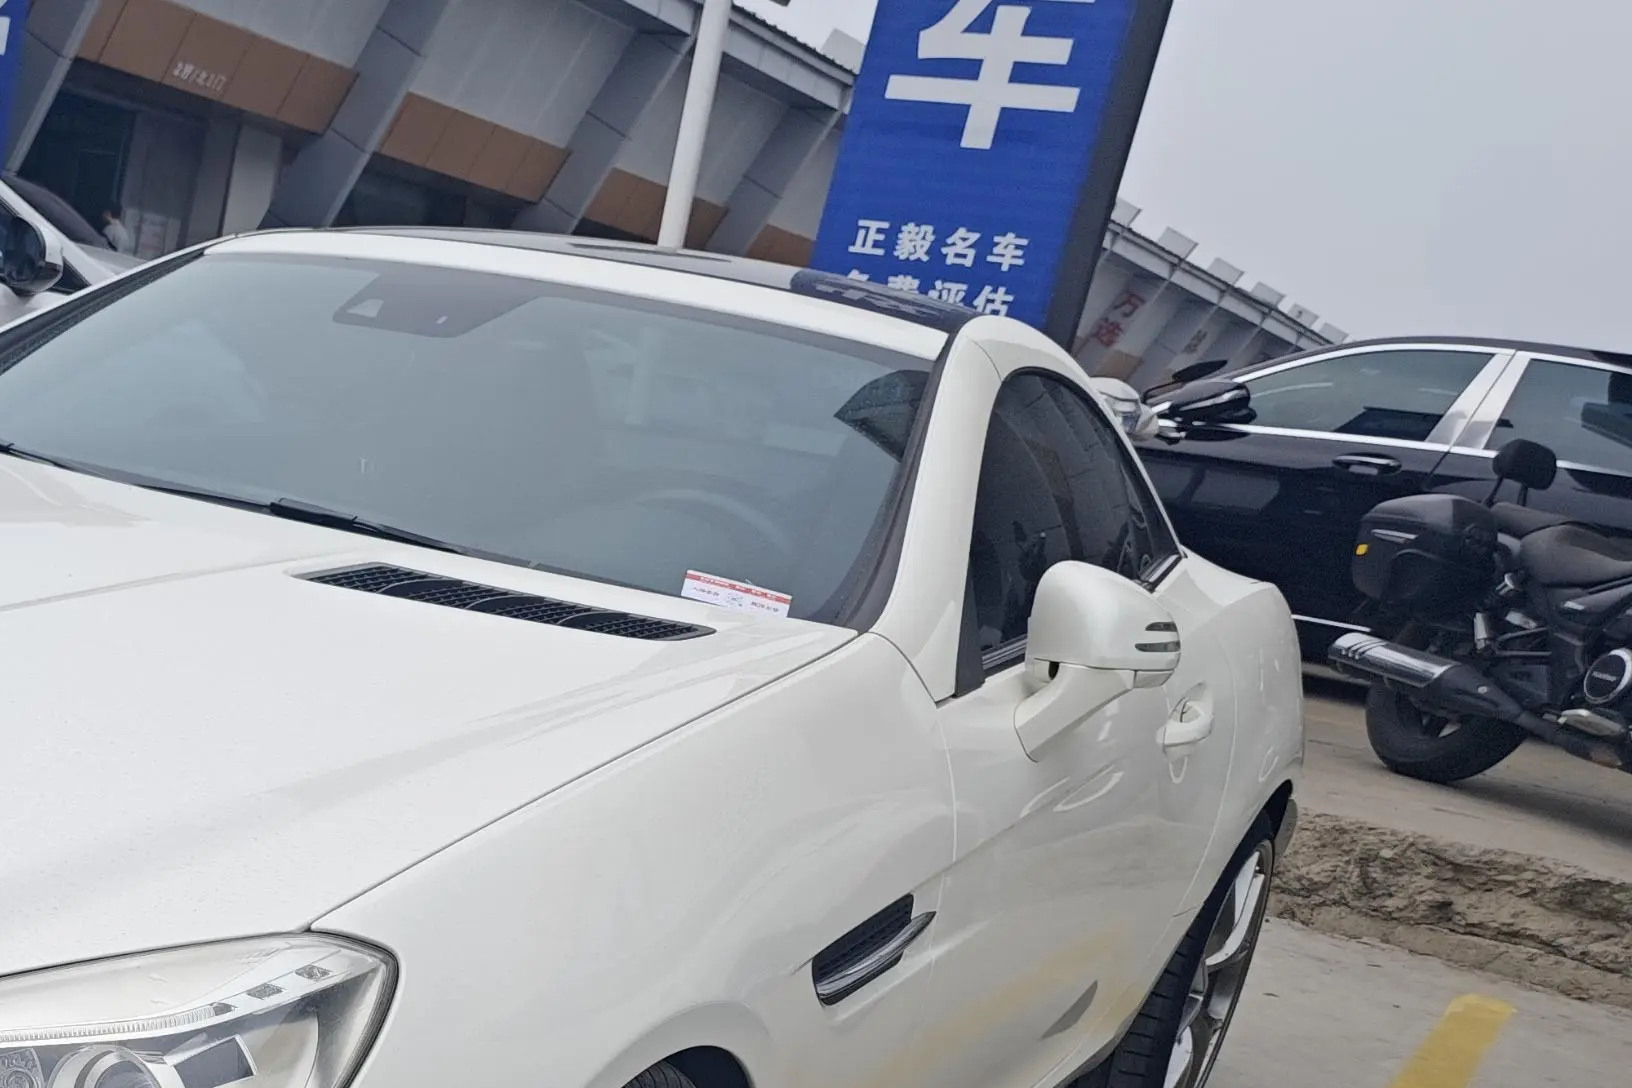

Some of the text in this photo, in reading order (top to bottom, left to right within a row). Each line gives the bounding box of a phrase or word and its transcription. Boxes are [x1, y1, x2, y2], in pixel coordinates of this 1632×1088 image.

[884, 0, 1092, 149] 车
[848, 219, 1029, 271] 正毅名车
